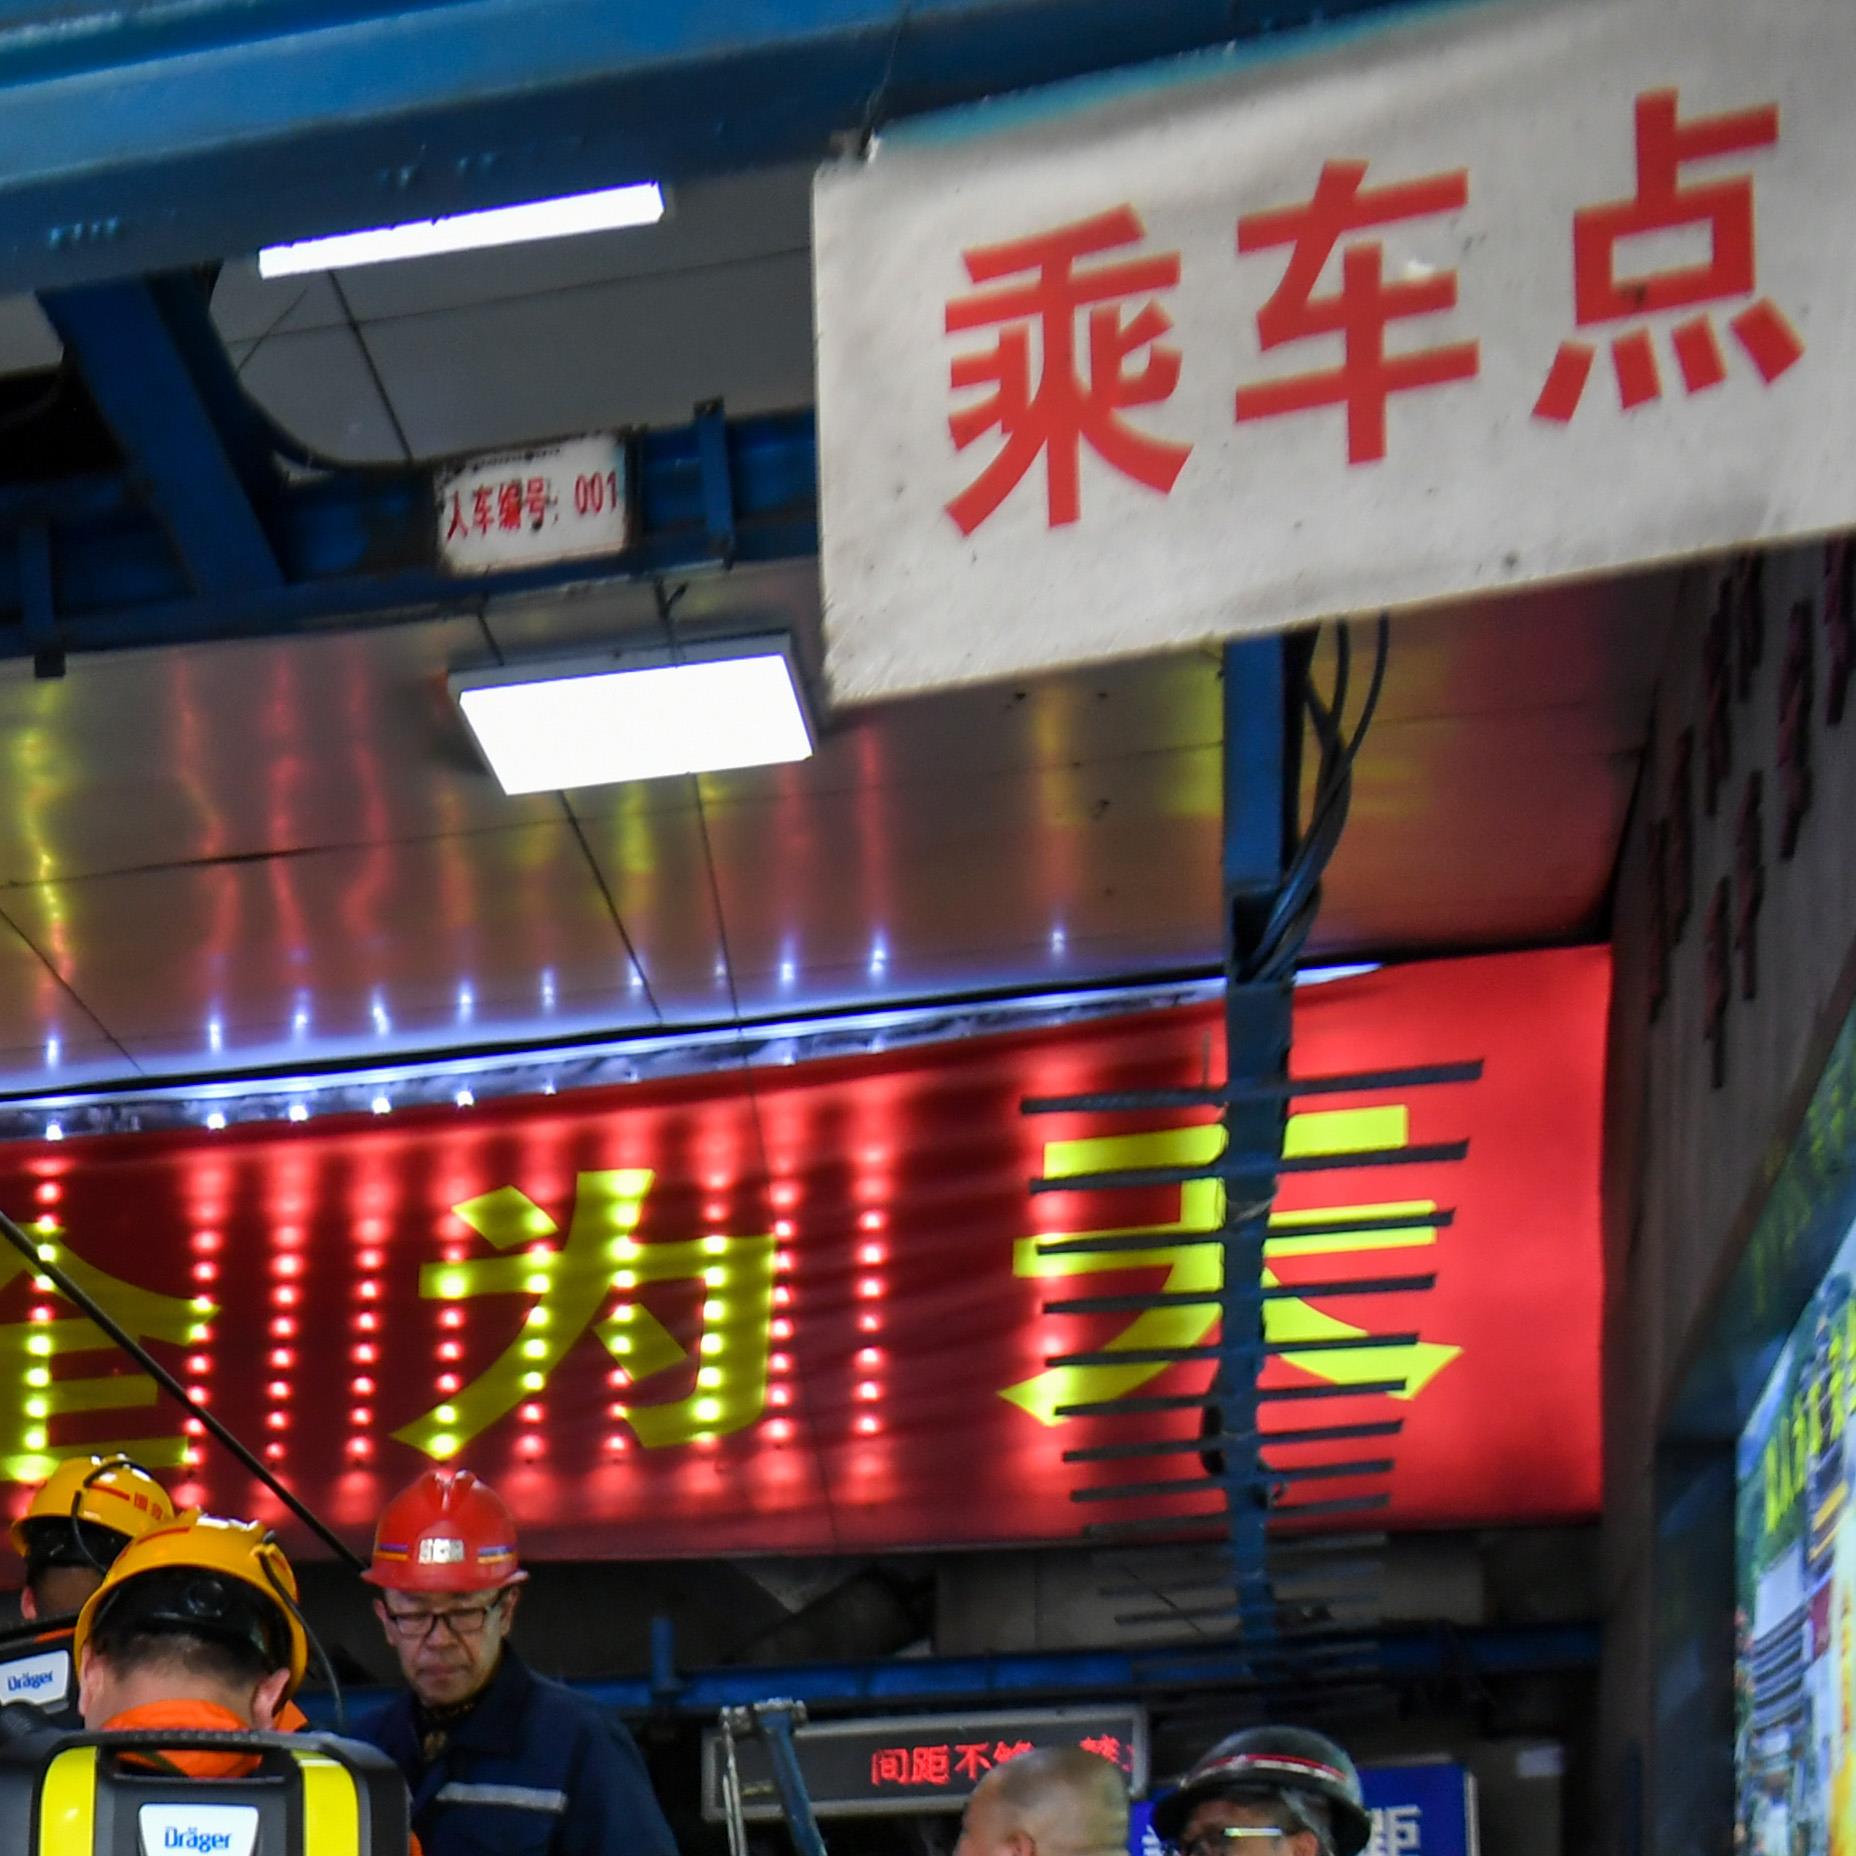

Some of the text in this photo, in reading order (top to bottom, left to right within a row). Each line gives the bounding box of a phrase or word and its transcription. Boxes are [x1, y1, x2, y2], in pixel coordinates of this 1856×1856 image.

[943, 87, 1805, 538] 乘车点
[8, 1670, 54, 1692] Dräger
[164, 1826, 233, 1853] Dräger
